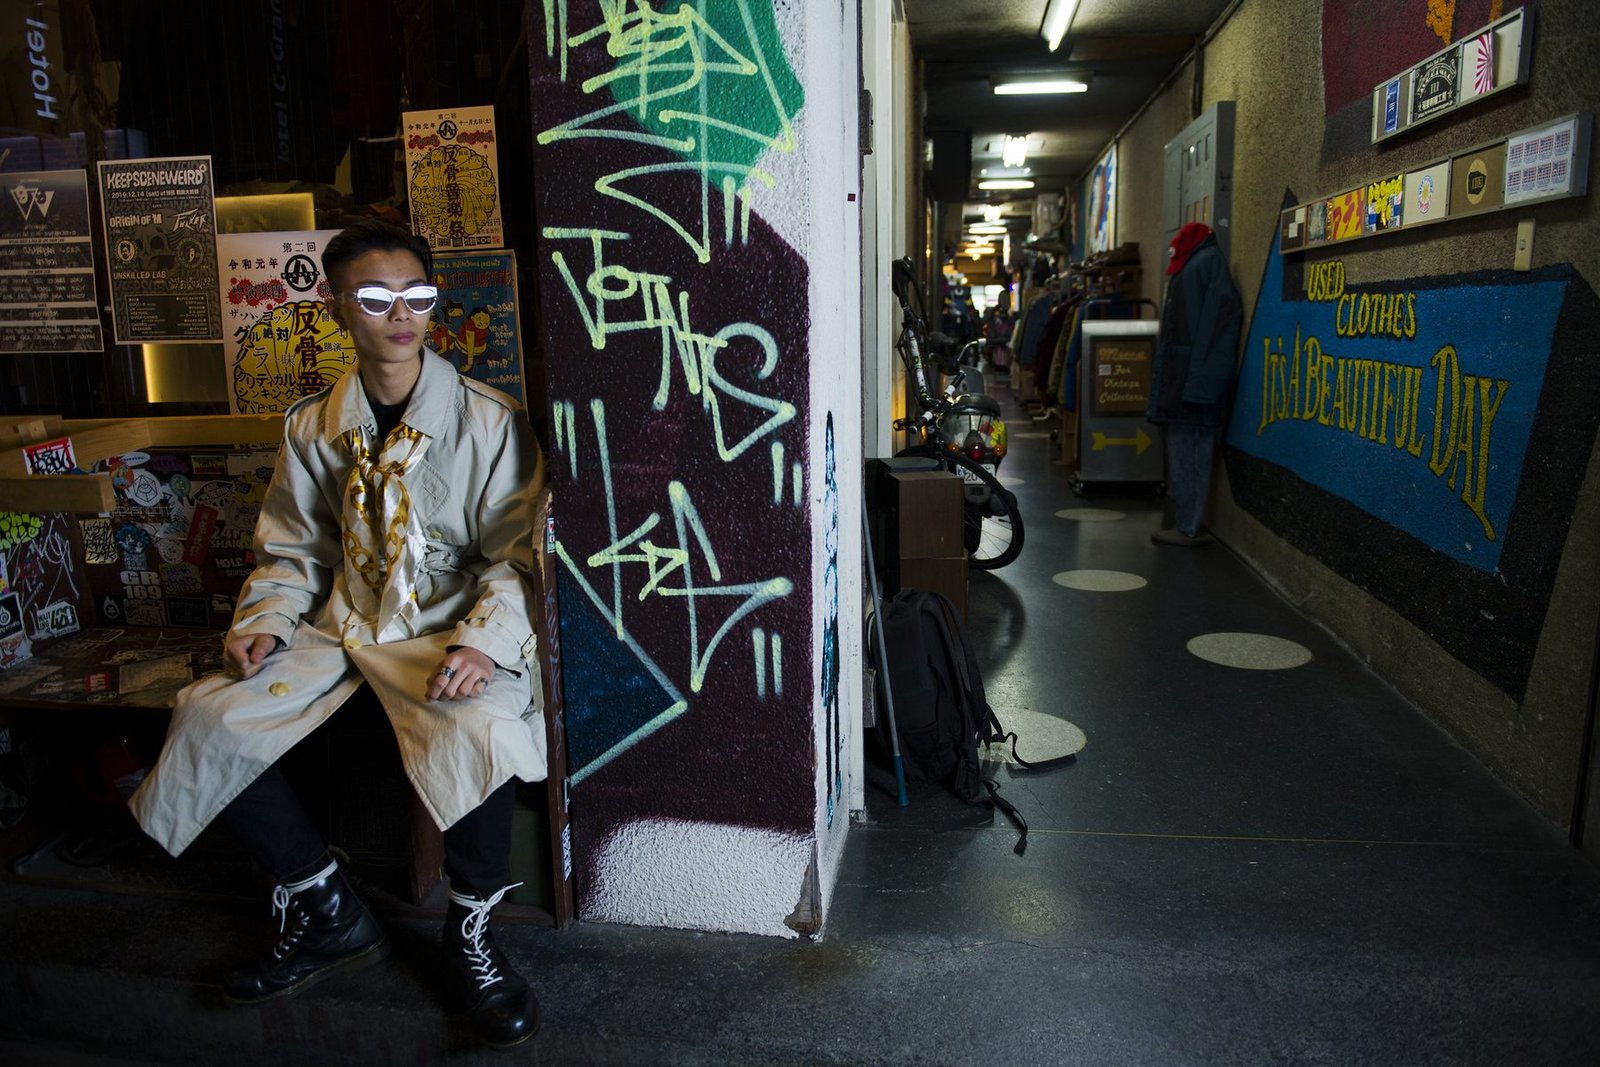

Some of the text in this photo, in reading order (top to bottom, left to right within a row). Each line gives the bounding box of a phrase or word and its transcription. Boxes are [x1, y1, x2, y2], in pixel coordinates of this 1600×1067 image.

[283, 241, 317, 254] 第二回
[228, 257, 279, 271] 令和元年
[113, 269, 166, 280] UNSKILLED LAB
[1307, 260, 1346, 302] USED
[1336, 292, 1418, 340] CLOTHES
[120, 570, 161, 586] GR
[123, 585, 162, 600] 169
